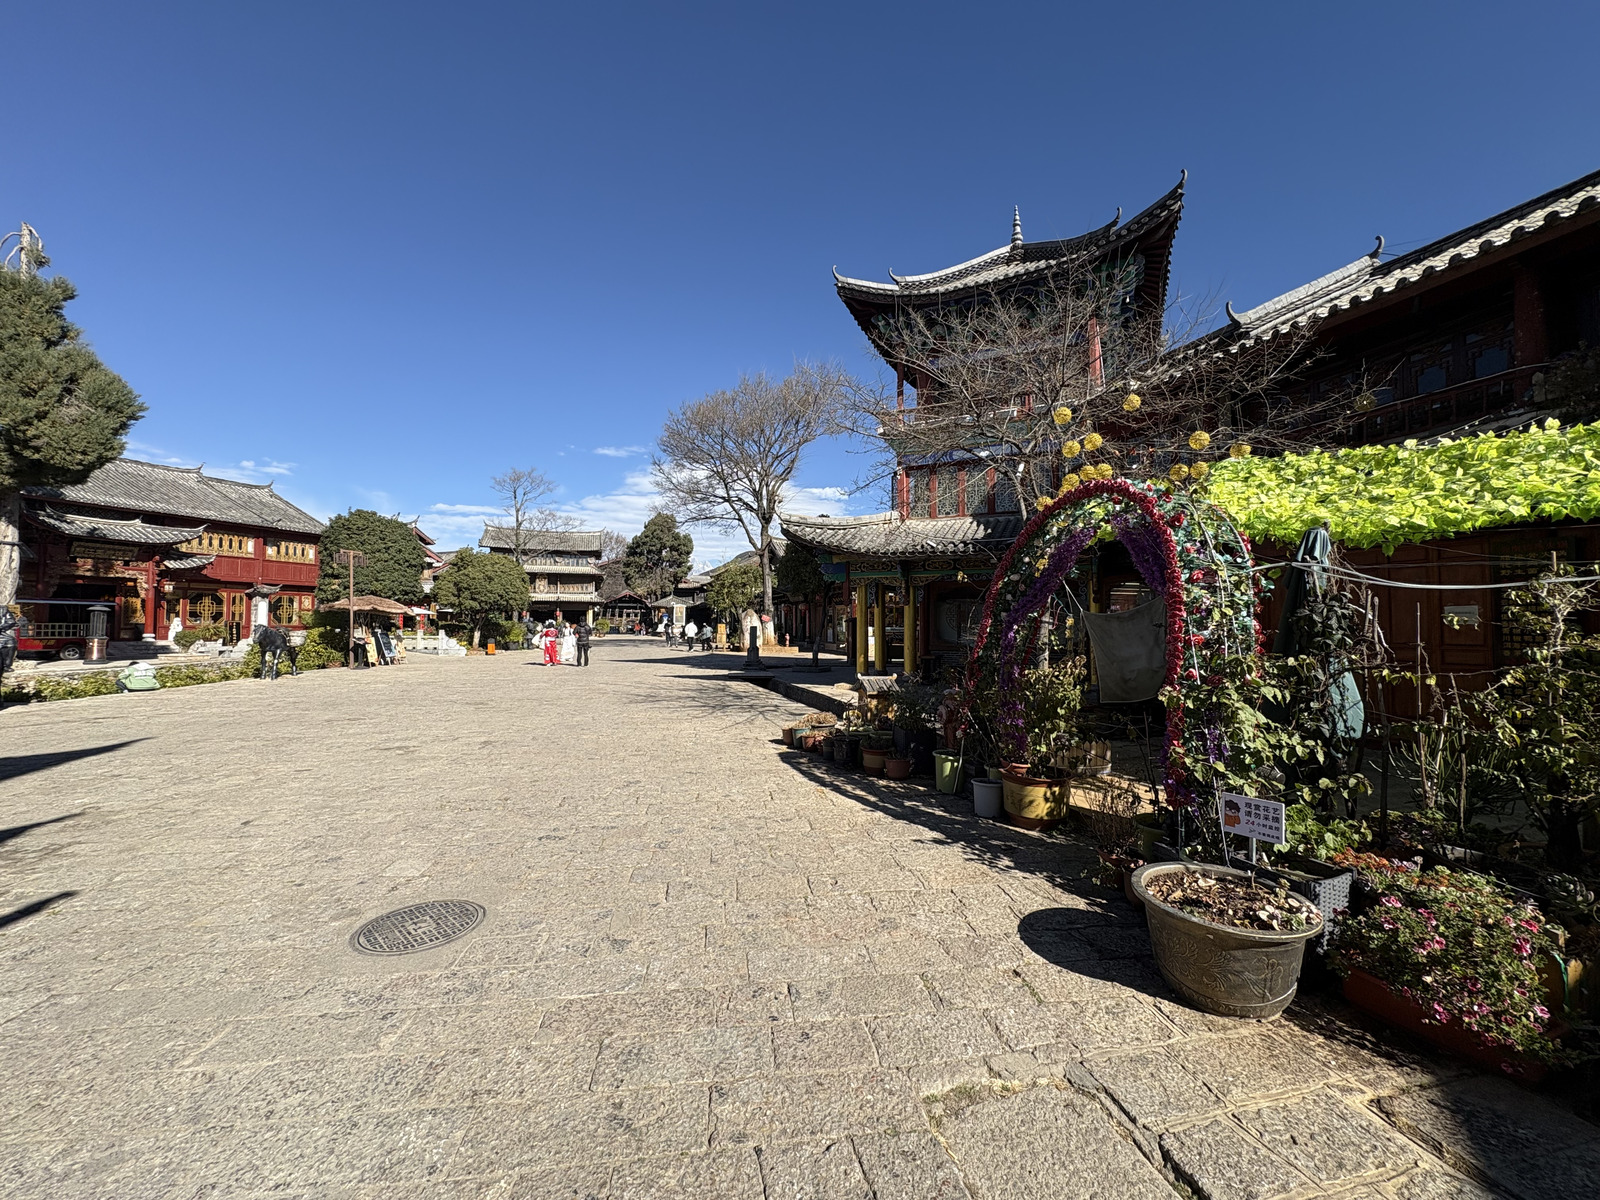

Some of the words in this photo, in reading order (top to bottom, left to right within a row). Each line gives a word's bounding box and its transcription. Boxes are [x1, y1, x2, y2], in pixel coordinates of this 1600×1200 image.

[1244, 802, 1280, 815] 观赏花艺
[1244, 810, 1280, 824] 请勿采摘
